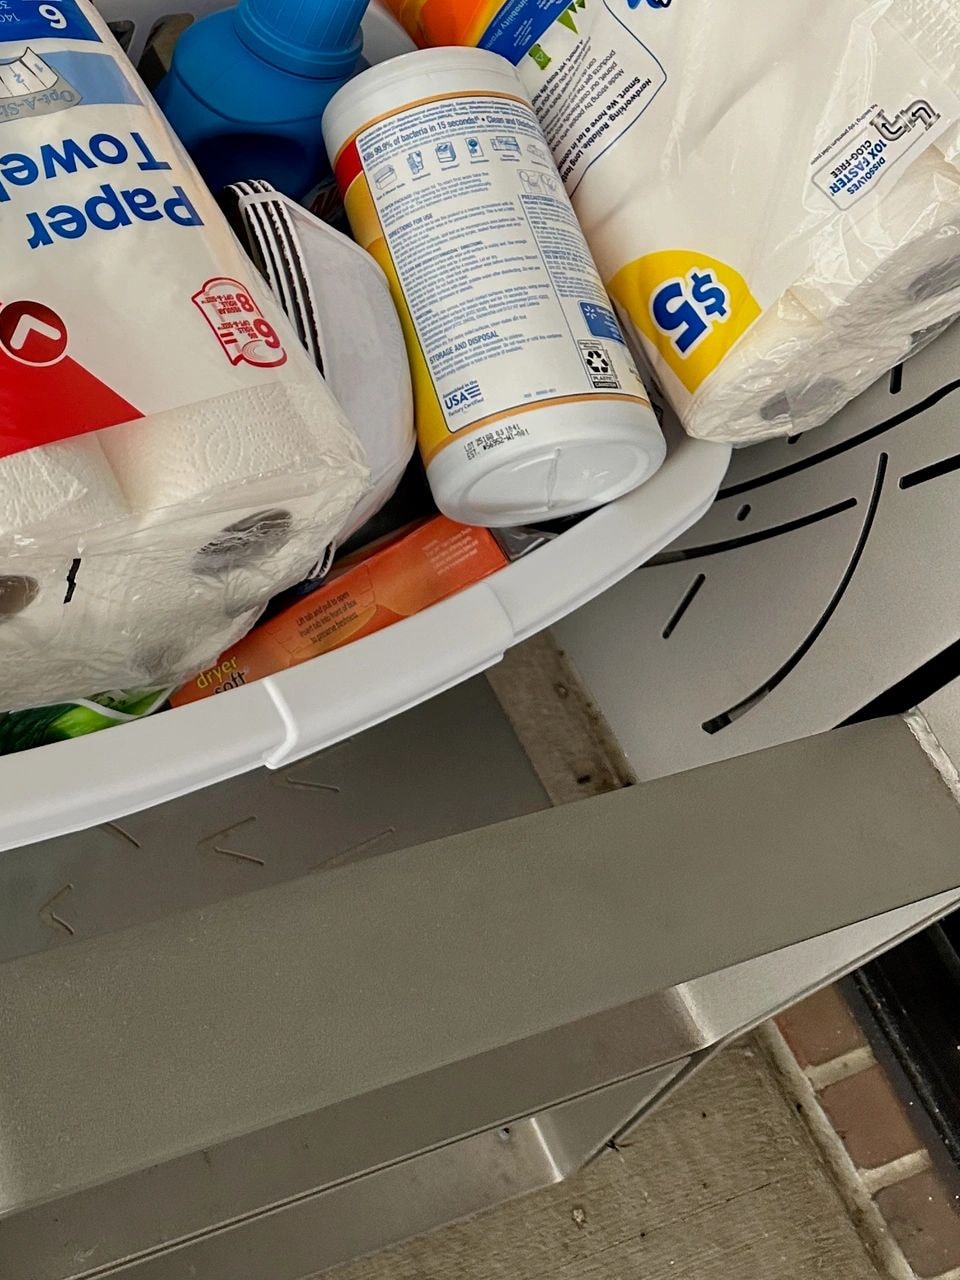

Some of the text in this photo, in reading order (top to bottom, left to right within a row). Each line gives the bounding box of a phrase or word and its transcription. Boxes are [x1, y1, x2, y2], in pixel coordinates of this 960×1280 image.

[37, 0, 67, 30] 6
[34, 62, 44, 73] 1
[589, 48, 616, 76] products
[596, 59, 618, 83] planet,
[13, 72, 24, 84] 2
[581, 73, 594, 86] get
[588, 79, 600, 91] our
[605, 66, 625, 86] Made
[548, 82, 560, 95] and
[588, 82, 609, 104] strong
[614, 74, 641, 101] Smart.
[581, 100, 593, 112] by
[604, 98, 618, 112] We
[605, 76, 652, 124] Hardworking.
[565, 107, 586, 130] people
[588, 109, 607, 129] have
[372, 139, 394, 155] 99.9%
[391, 136, 401, 146] of
[399, 126, 429, 143] bacteria
[427, 123, 437, 132] in
[436, 120, 447, 130] 15
[569, 141, 578, 151] in
[574, 131, 586, 144] lot
[578, 120, 609, 152] Reliable.
[567, 148, 584, 167] Long
[829, 138, 873, 179] CLOG-FREE
[866, 138, 887, 160] 10X
[845, 155, 886, 195] DISSOLVES
[27, 187, 205, 249] Paper
[234, 291, 254, 313] 8
[651, 272, 726, 354] $5
[252, 315, 280, 351] 6
[428, 329, 499, 364] STORAGE AND DISPOSAL
[443, 390, 469, 409] USA
[447, 396, 484, 416] Factory Certified
[463, 440, 476, 452] LOT
[197, 655, 237, 688] dryer
[213, 671, 245, 694] soft
